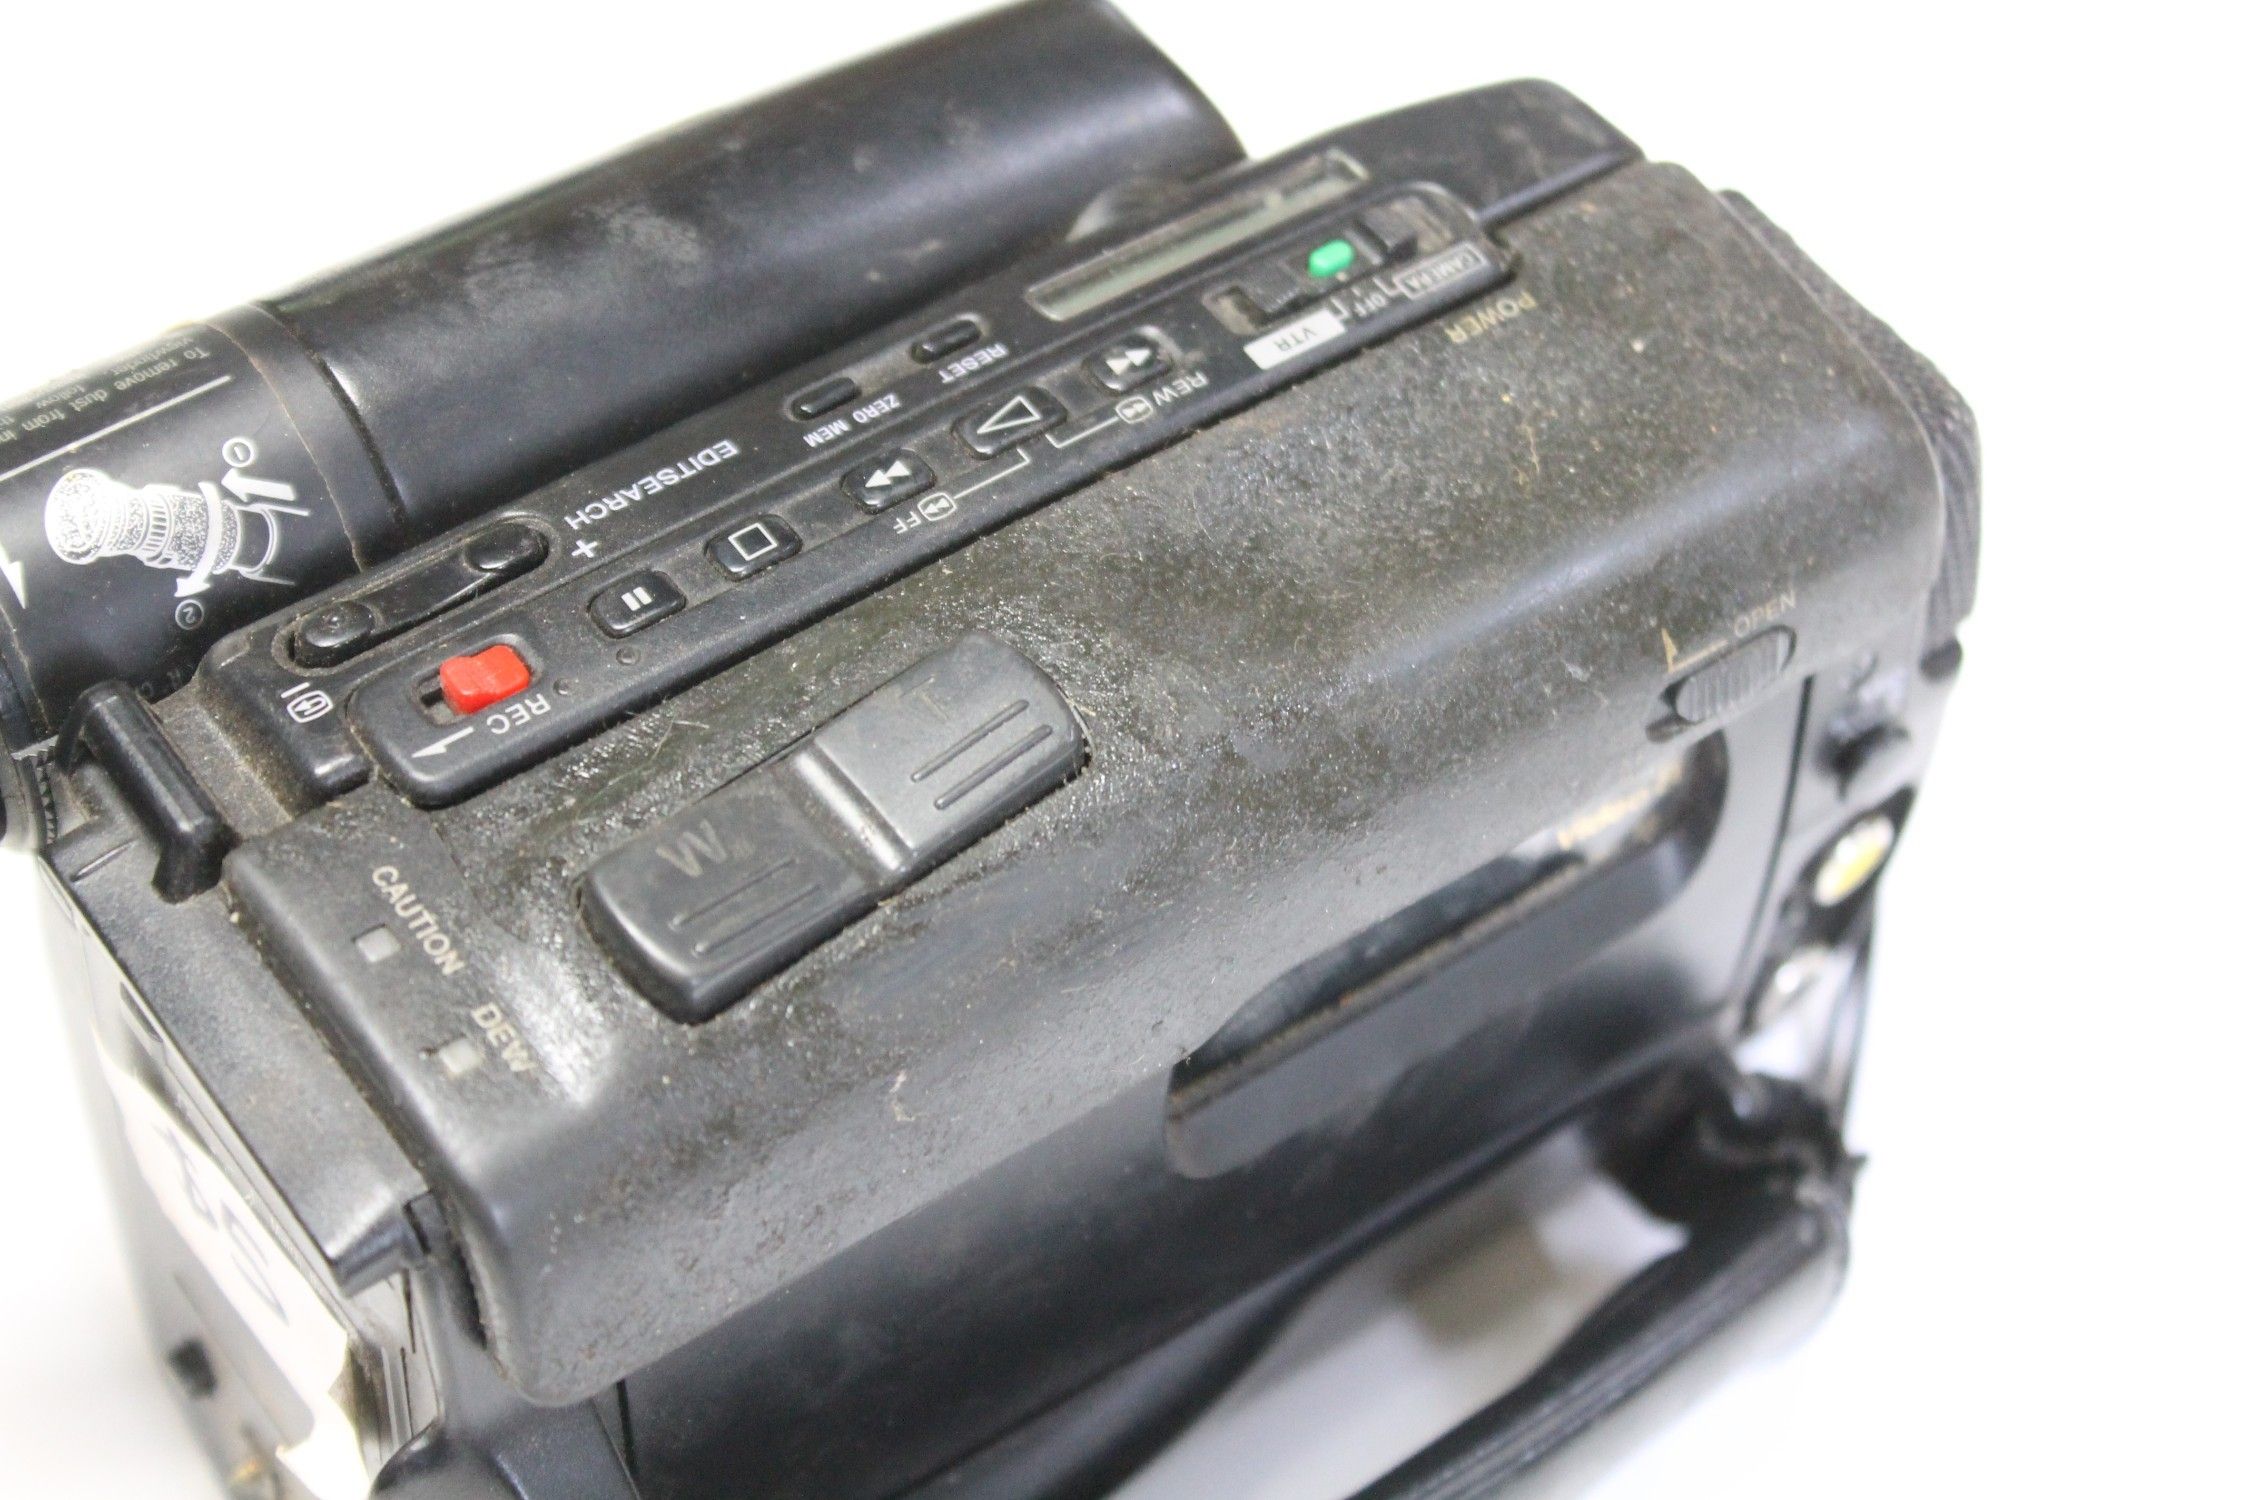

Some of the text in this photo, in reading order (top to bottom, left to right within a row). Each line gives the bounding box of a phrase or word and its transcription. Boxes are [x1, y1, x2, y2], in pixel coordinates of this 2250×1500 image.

[1352, 291, 1387, 317] OFF
[1444, 291, 1537, 344] POWER
[183, 346, 210, 360] To
[1273, 327, 1318, 351] VTR
[114, 358, 178, 390] remove
[938, 342, 1009, 384] RESET
[71, 388, 109, 412] dust
[1152, 371, 1209, 408] REW
[21, 408, 67, 432] from
[802, 392, 901, 449] ZERO MEM
[563, 438, 740, 530] EDITSEARCH
[892, 510, 923, 535] FF
[1734, 588, 1797, 638] OPEN
[485, 693, 551, 736] REC
[371, 864, 468, 976] CAUTION
[470, 1001, 538, 1073] DEW
